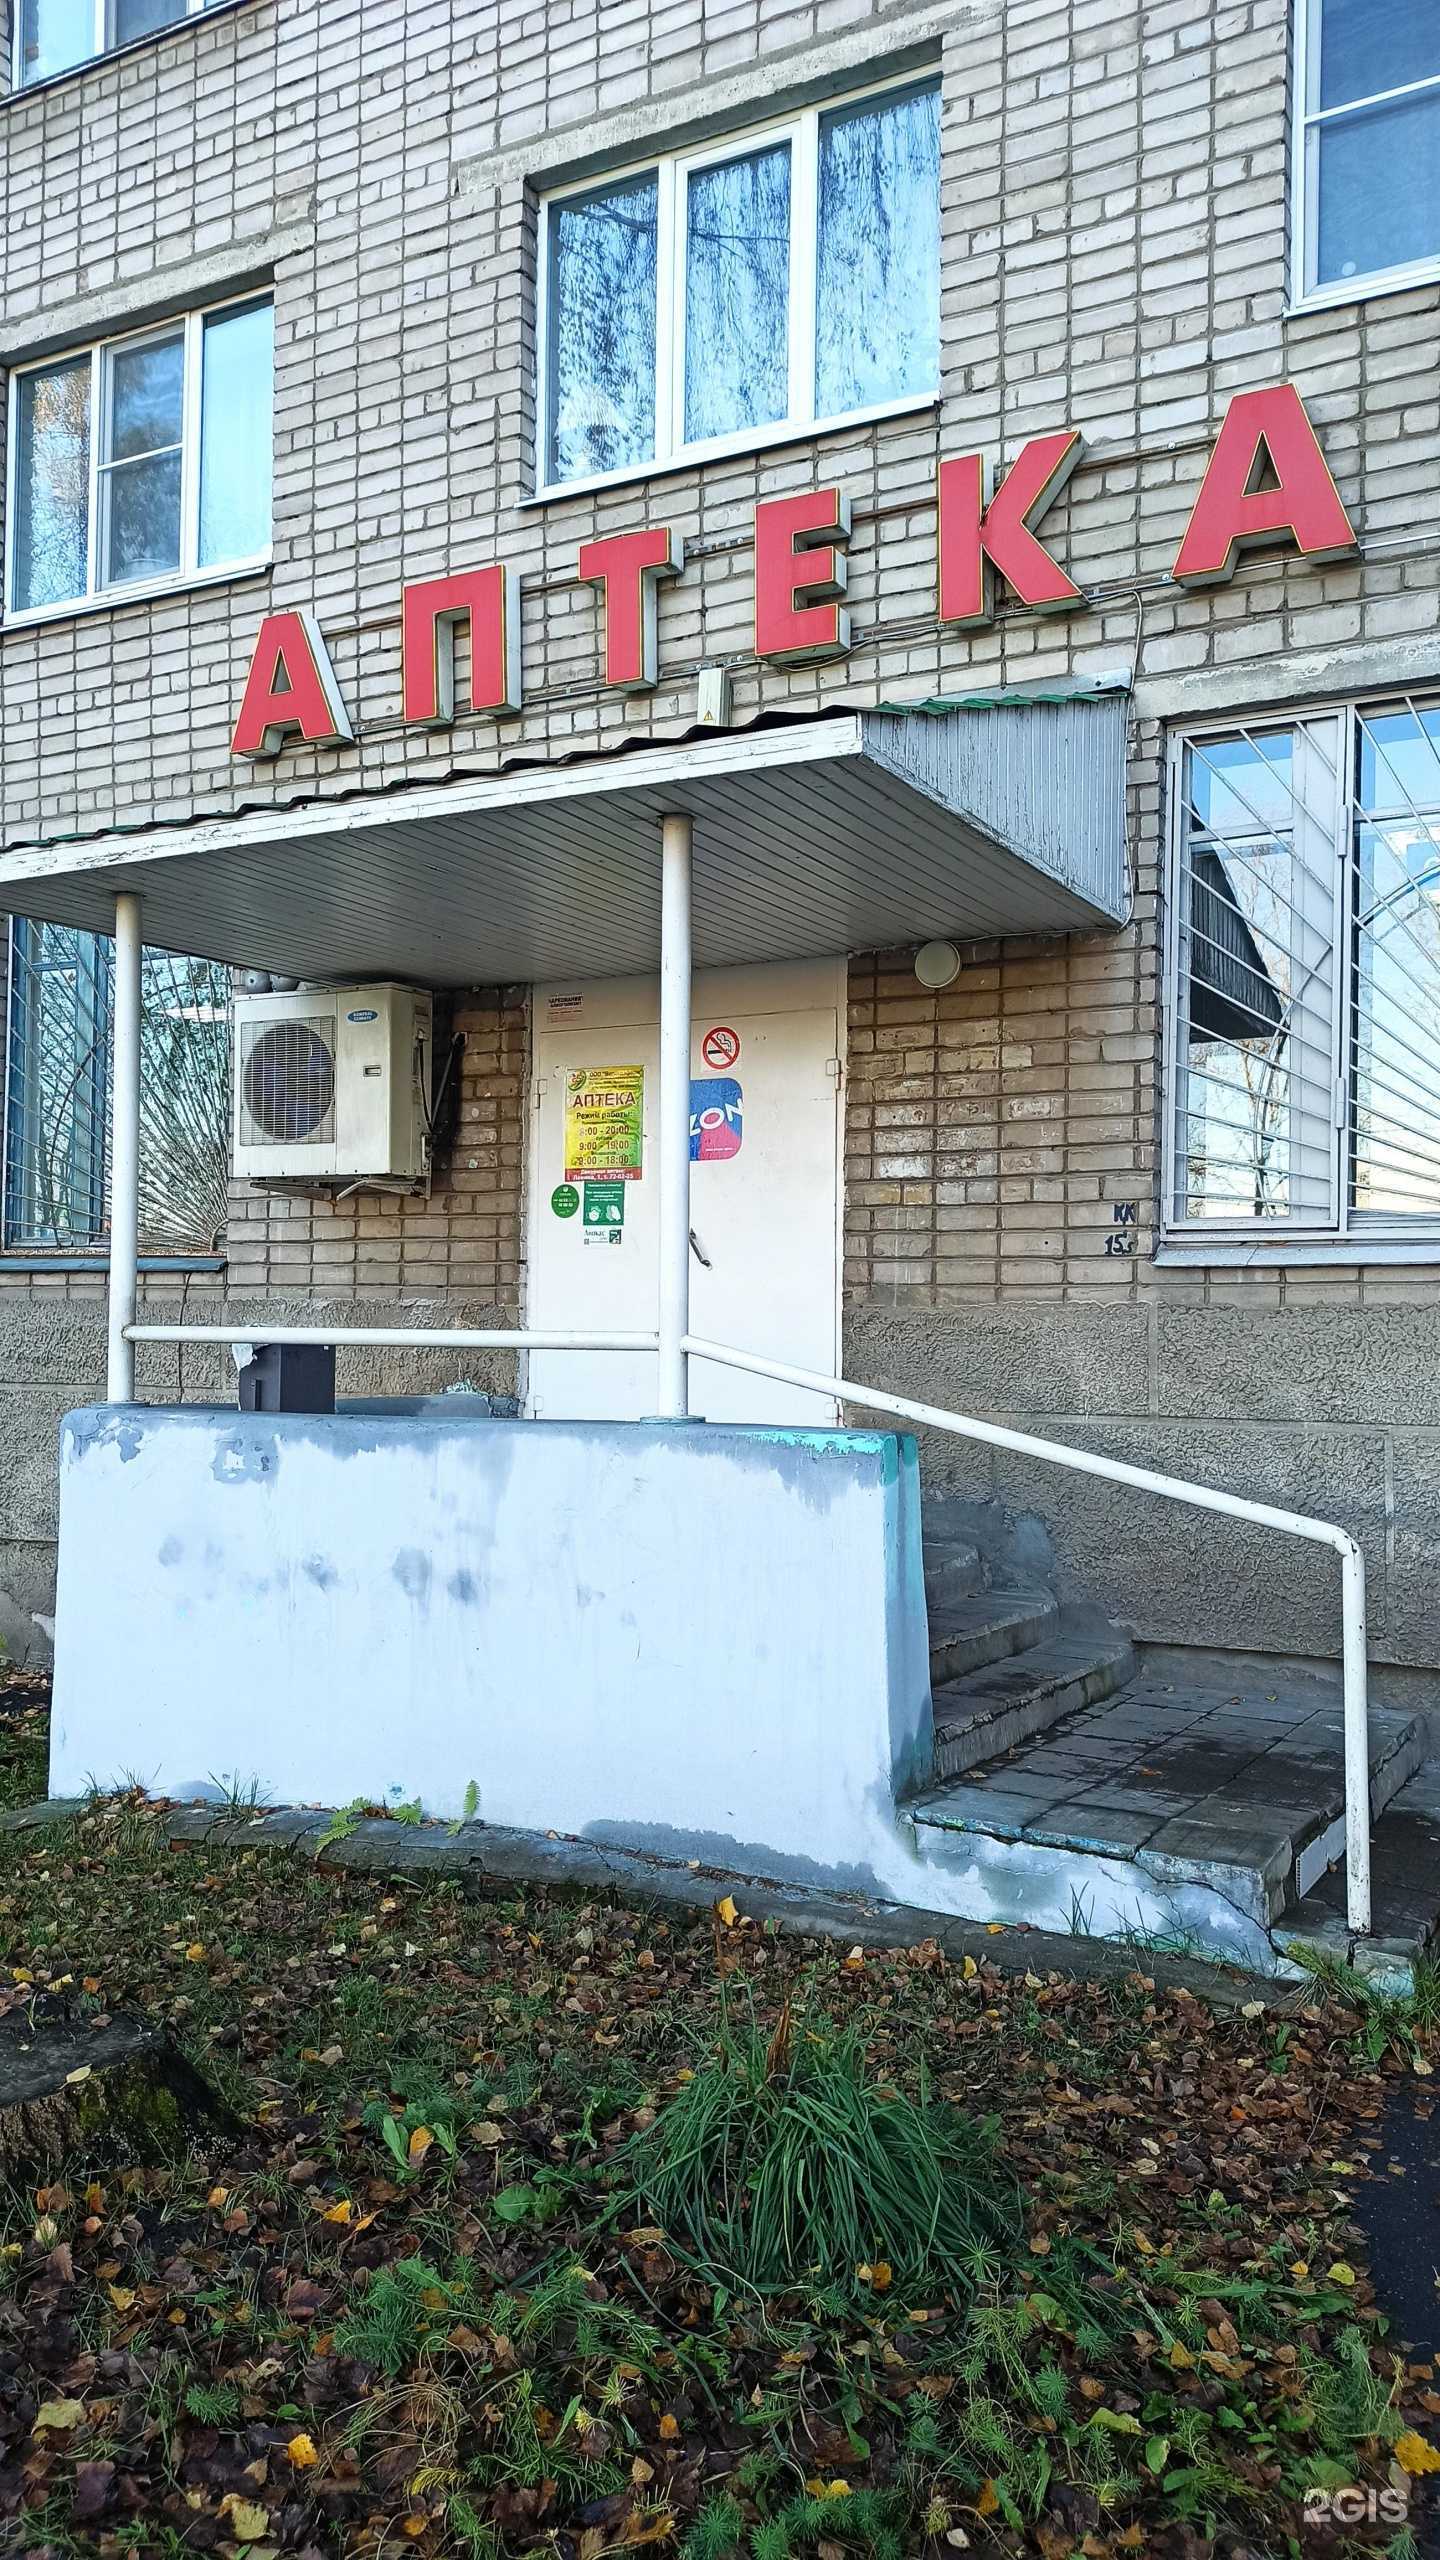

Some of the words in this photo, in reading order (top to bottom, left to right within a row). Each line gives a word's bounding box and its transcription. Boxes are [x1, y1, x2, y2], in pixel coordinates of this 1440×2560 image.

[230, 383, 1359, 758] АПТЕКА
[573, 1091, 636, 1108] АПТЕКА
[690, 1098, 743, 1136] ZON
[579, 1127, 597, 1136] 8:00
[605, 1125, 629, 1135] 20:00
[579, 1142, 597, 1151] 9:00
[607, 1140, 629, 1150] 19:00
[607, 1155, 629, 1164] 18:00
